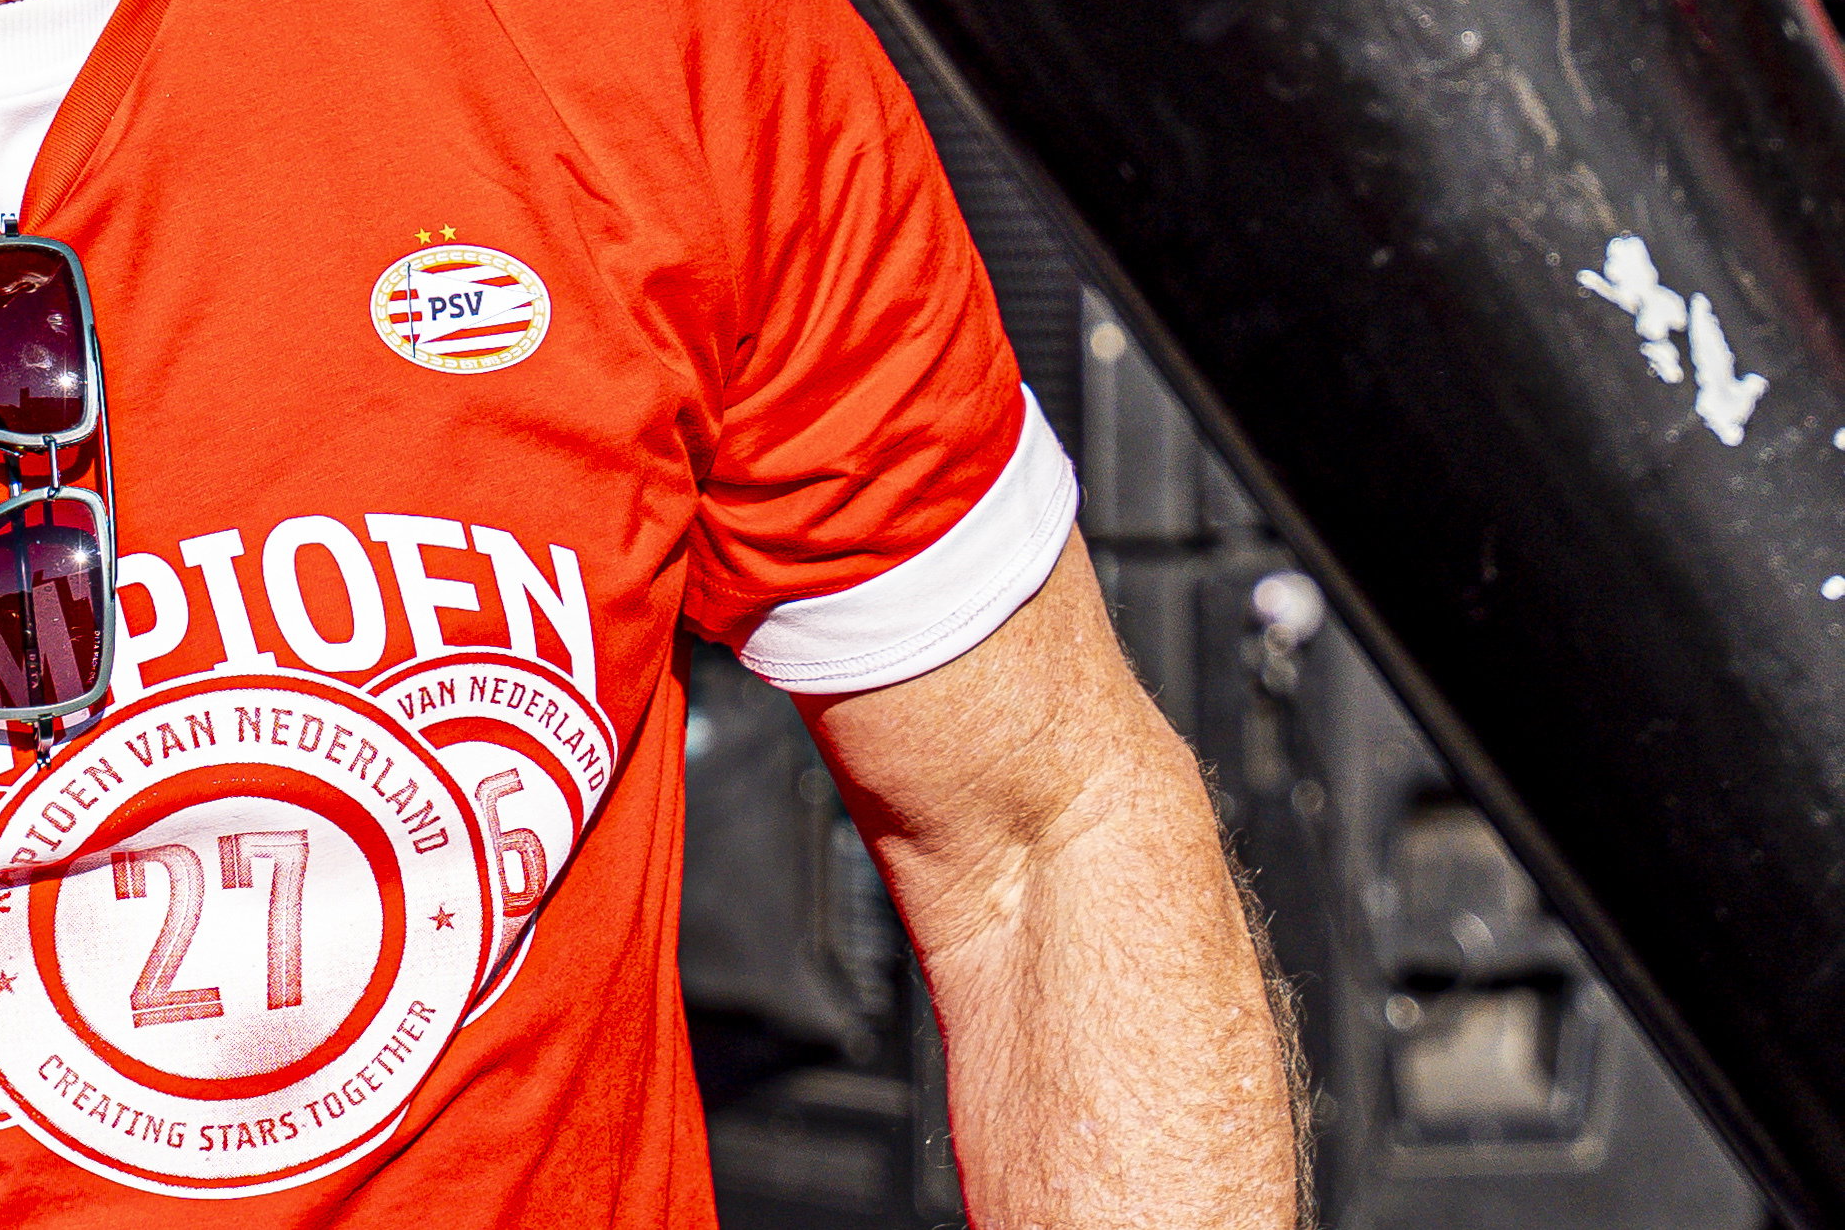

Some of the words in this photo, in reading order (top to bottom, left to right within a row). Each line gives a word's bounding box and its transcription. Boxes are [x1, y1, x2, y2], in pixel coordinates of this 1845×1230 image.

[428, 291, 484, 321] PSV
[125, 711, 215, 767] VAN
[235, 707, 449, 855] NEDERLAND
[397, 679, 455, 720] VAN
[470, 676, 605, 792] NEDERLAND
[111, 829, 309, 1028] 27
[38, 1054, 186, 1150] CREATING
[199, 1111, 298, 1152] STARS
[304, 1000, 436, 1128] TOGETHER
